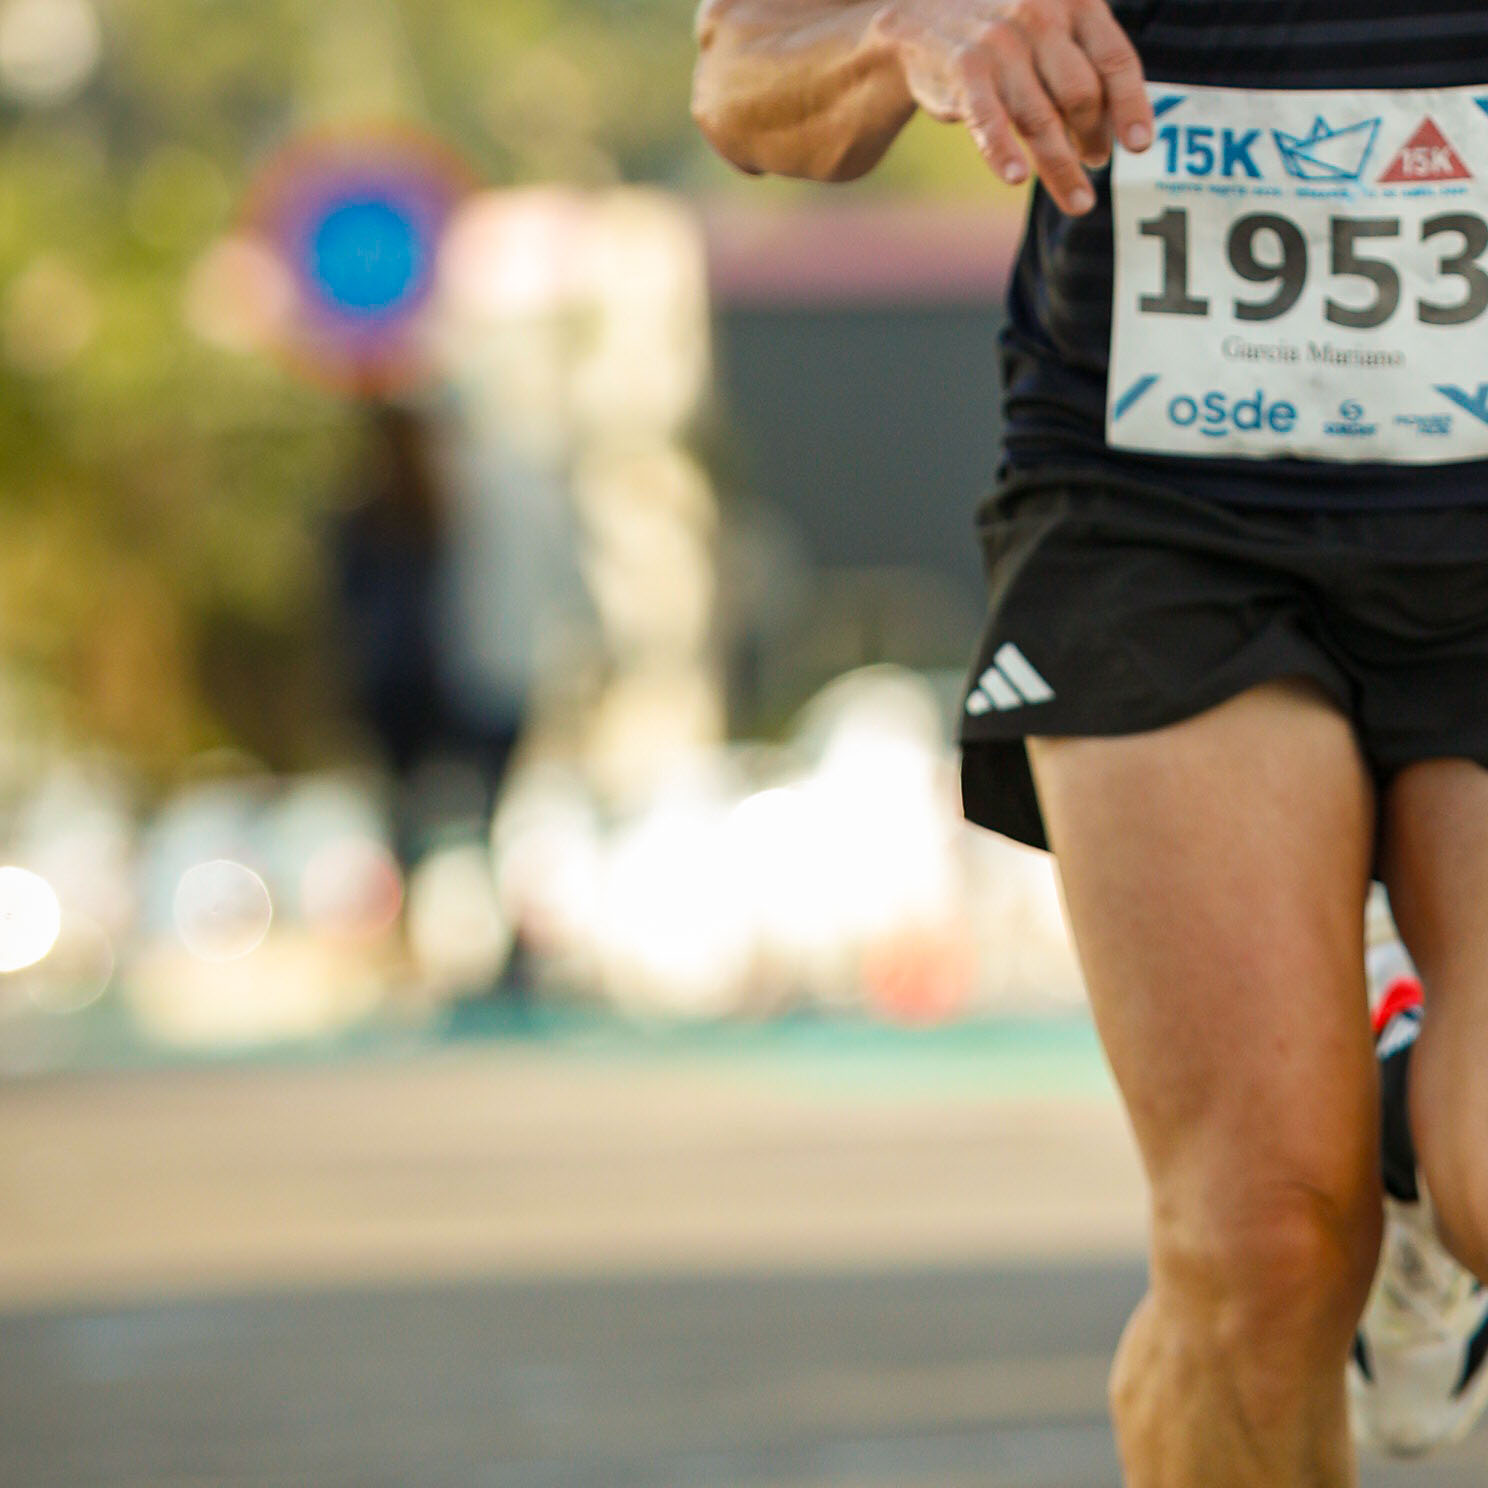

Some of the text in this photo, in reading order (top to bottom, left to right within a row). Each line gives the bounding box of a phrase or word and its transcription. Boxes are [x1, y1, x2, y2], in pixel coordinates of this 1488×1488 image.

[1158, 123, 1264, 180] 15K
[1401, 146, 1455, 176] 15K
[1306, 340, 1406, 369] Mariano
[1167, 389, 1298, 437] osde
